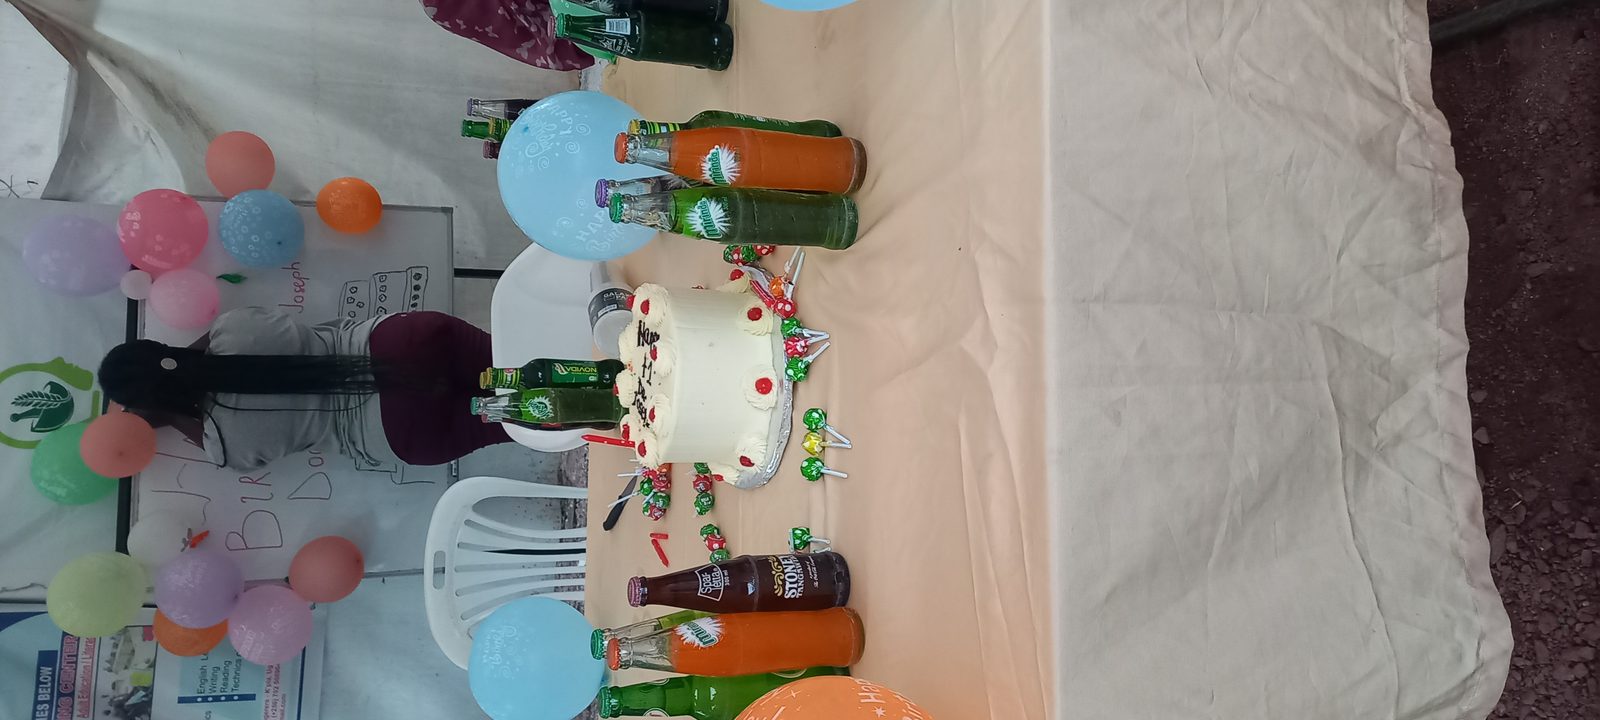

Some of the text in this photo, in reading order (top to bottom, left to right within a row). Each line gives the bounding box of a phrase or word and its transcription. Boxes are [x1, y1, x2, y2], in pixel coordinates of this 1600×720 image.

[708, 152, 729, 186] Mirinda
[694, 200, 722, 238] Mirinda
[277, 261, 310, 314] Joseph
[225, 471, 284, 551] BIR
[723, 576, 731, 586] 300
[60, 635, 78, 693] CENTER
[197, 665, 208, 694] English
[209, 666, 221, 694] Writing
[220, 660, 232, 693] Reading
[38, 666, 53, 701] BELOW
